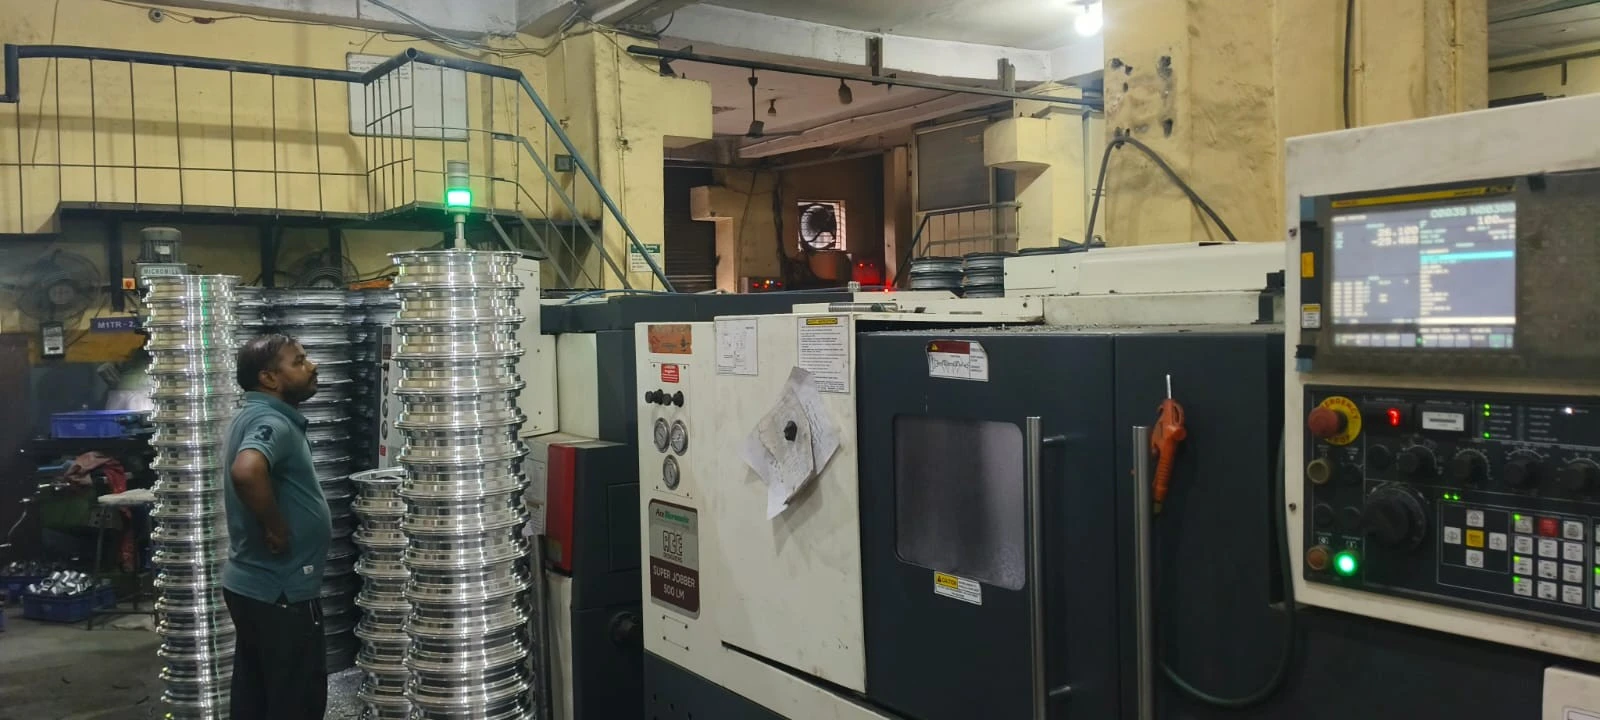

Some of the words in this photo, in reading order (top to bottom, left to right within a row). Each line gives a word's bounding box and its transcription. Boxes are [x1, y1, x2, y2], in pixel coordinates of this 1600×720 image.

[254, 424, 274, 442] 3
[653, 565, 670, 580] SUPER
[672, 571, 696, 588] JOBBER
[663, 583, 675, 597] 500
[675, 587, 686, 600] LM
